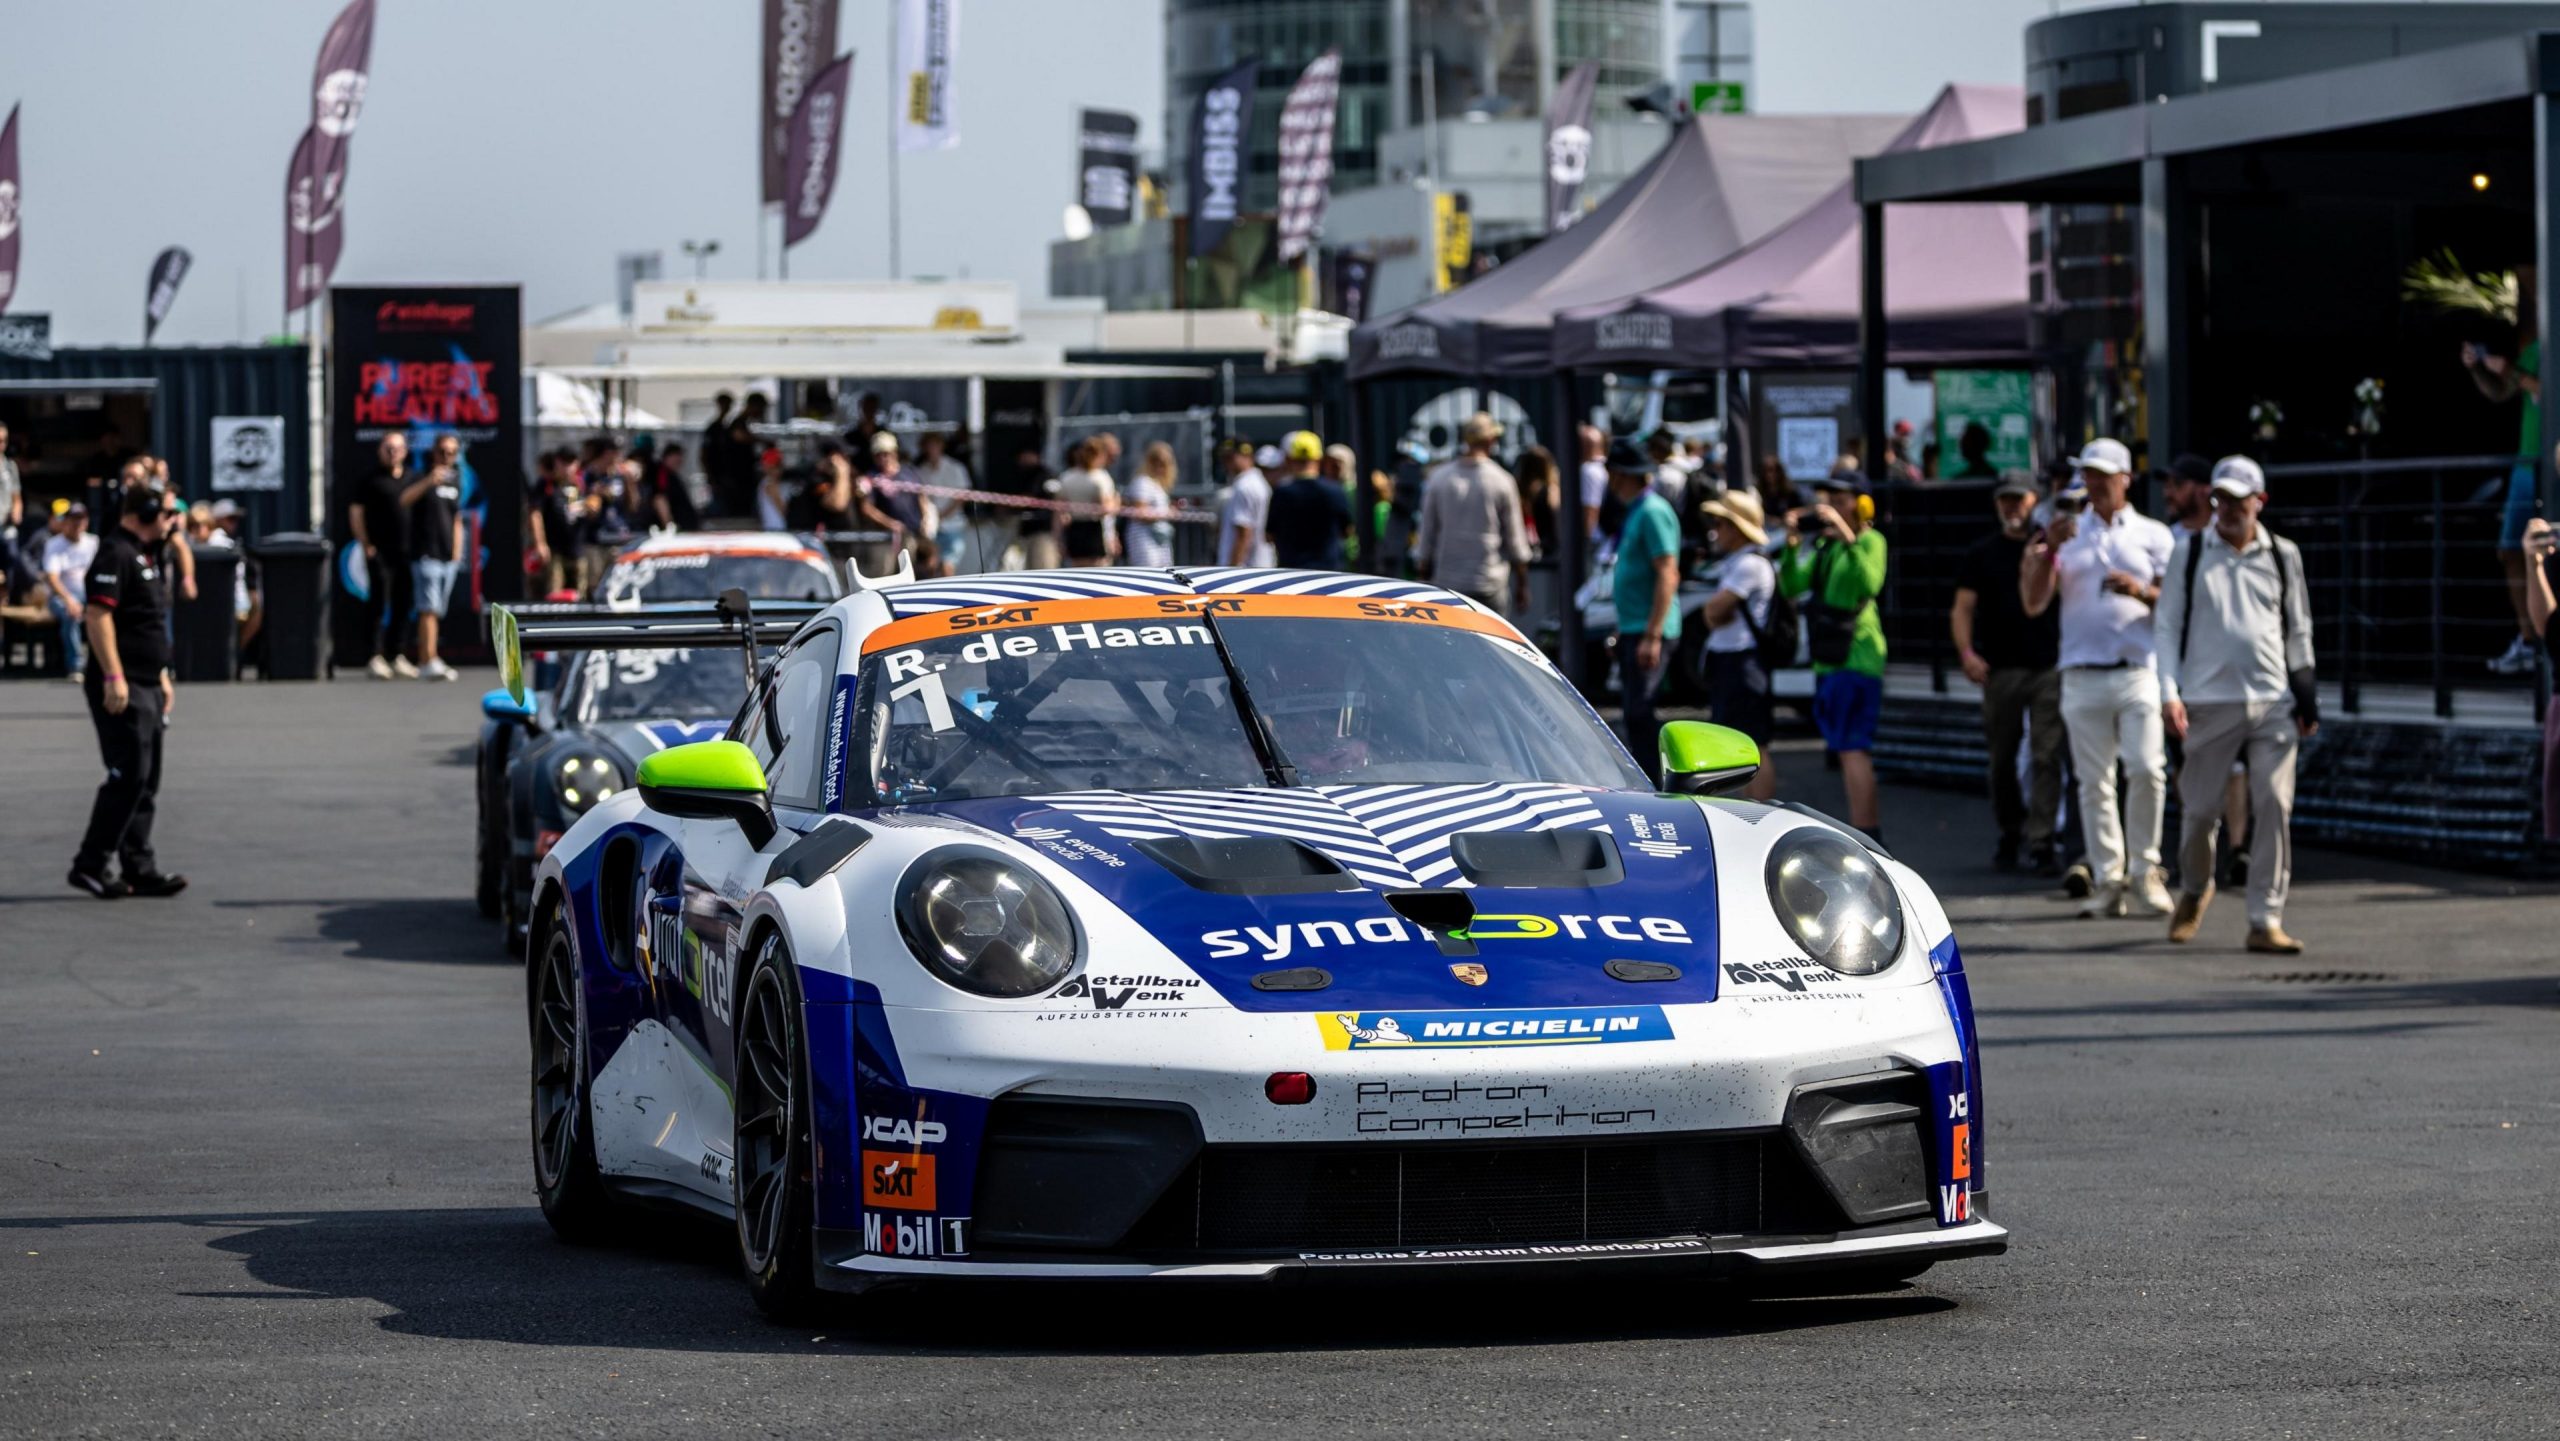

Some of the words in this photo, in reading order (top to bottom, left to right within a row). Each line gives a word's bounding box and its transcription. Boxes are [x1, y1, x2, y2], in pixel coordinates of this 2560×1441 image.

[1202, 87, 1241, 220] IMBISS
[360, 361, 495, 394] PUREST
[354, 393, 499, 424] HEATING
[884, 649, 947, 683] R.
[961, 634, 1039, 664] de
[1052, 622, 1215, 652] Haan
[1091, 987, 1186, 1010] Wenk
[1752, 992, 1866, 1004] AUFZUGSTECHNIK
[1036, 1010, 1190, 1022] AUFZUGSTECHNIK
[1423, 1016, 1640, 1038] MICHELIN
[1357, 1080, 1548, 1104] Proton
[1357, 1105, 1656, 1135] Competition
[864, 1212, 934, 1256] Mobil
[950, 1221, 964, 1253] 1
[1301, 1252, 1409, 1260] Porsche
[1411, 1249, 1528, 1258] Zentrum
[1529, 1240, 1703, 1255] Niederbayern
